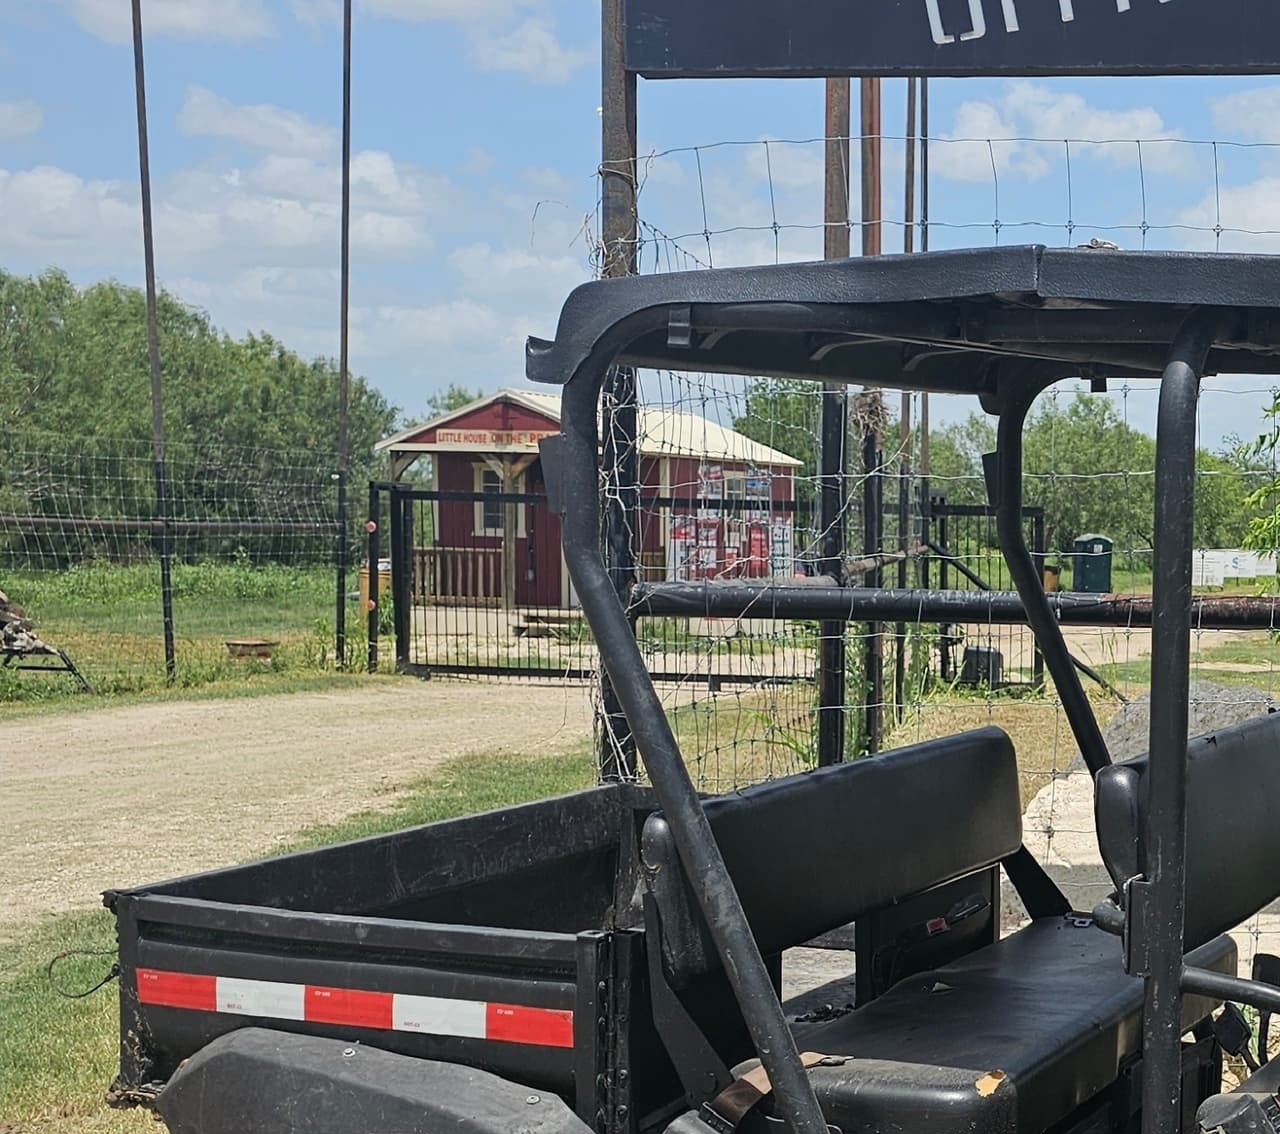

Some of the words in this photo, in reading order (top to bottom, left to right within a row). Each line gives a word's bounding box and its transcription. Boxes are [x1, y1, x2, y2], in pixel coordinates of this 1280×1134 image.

[438, 432, 461, 443] LITTLE
[464, 433, 487, 444] HOUSE
[491, 432, 503, 443] ON
[506, 433, 522, 444] THE
